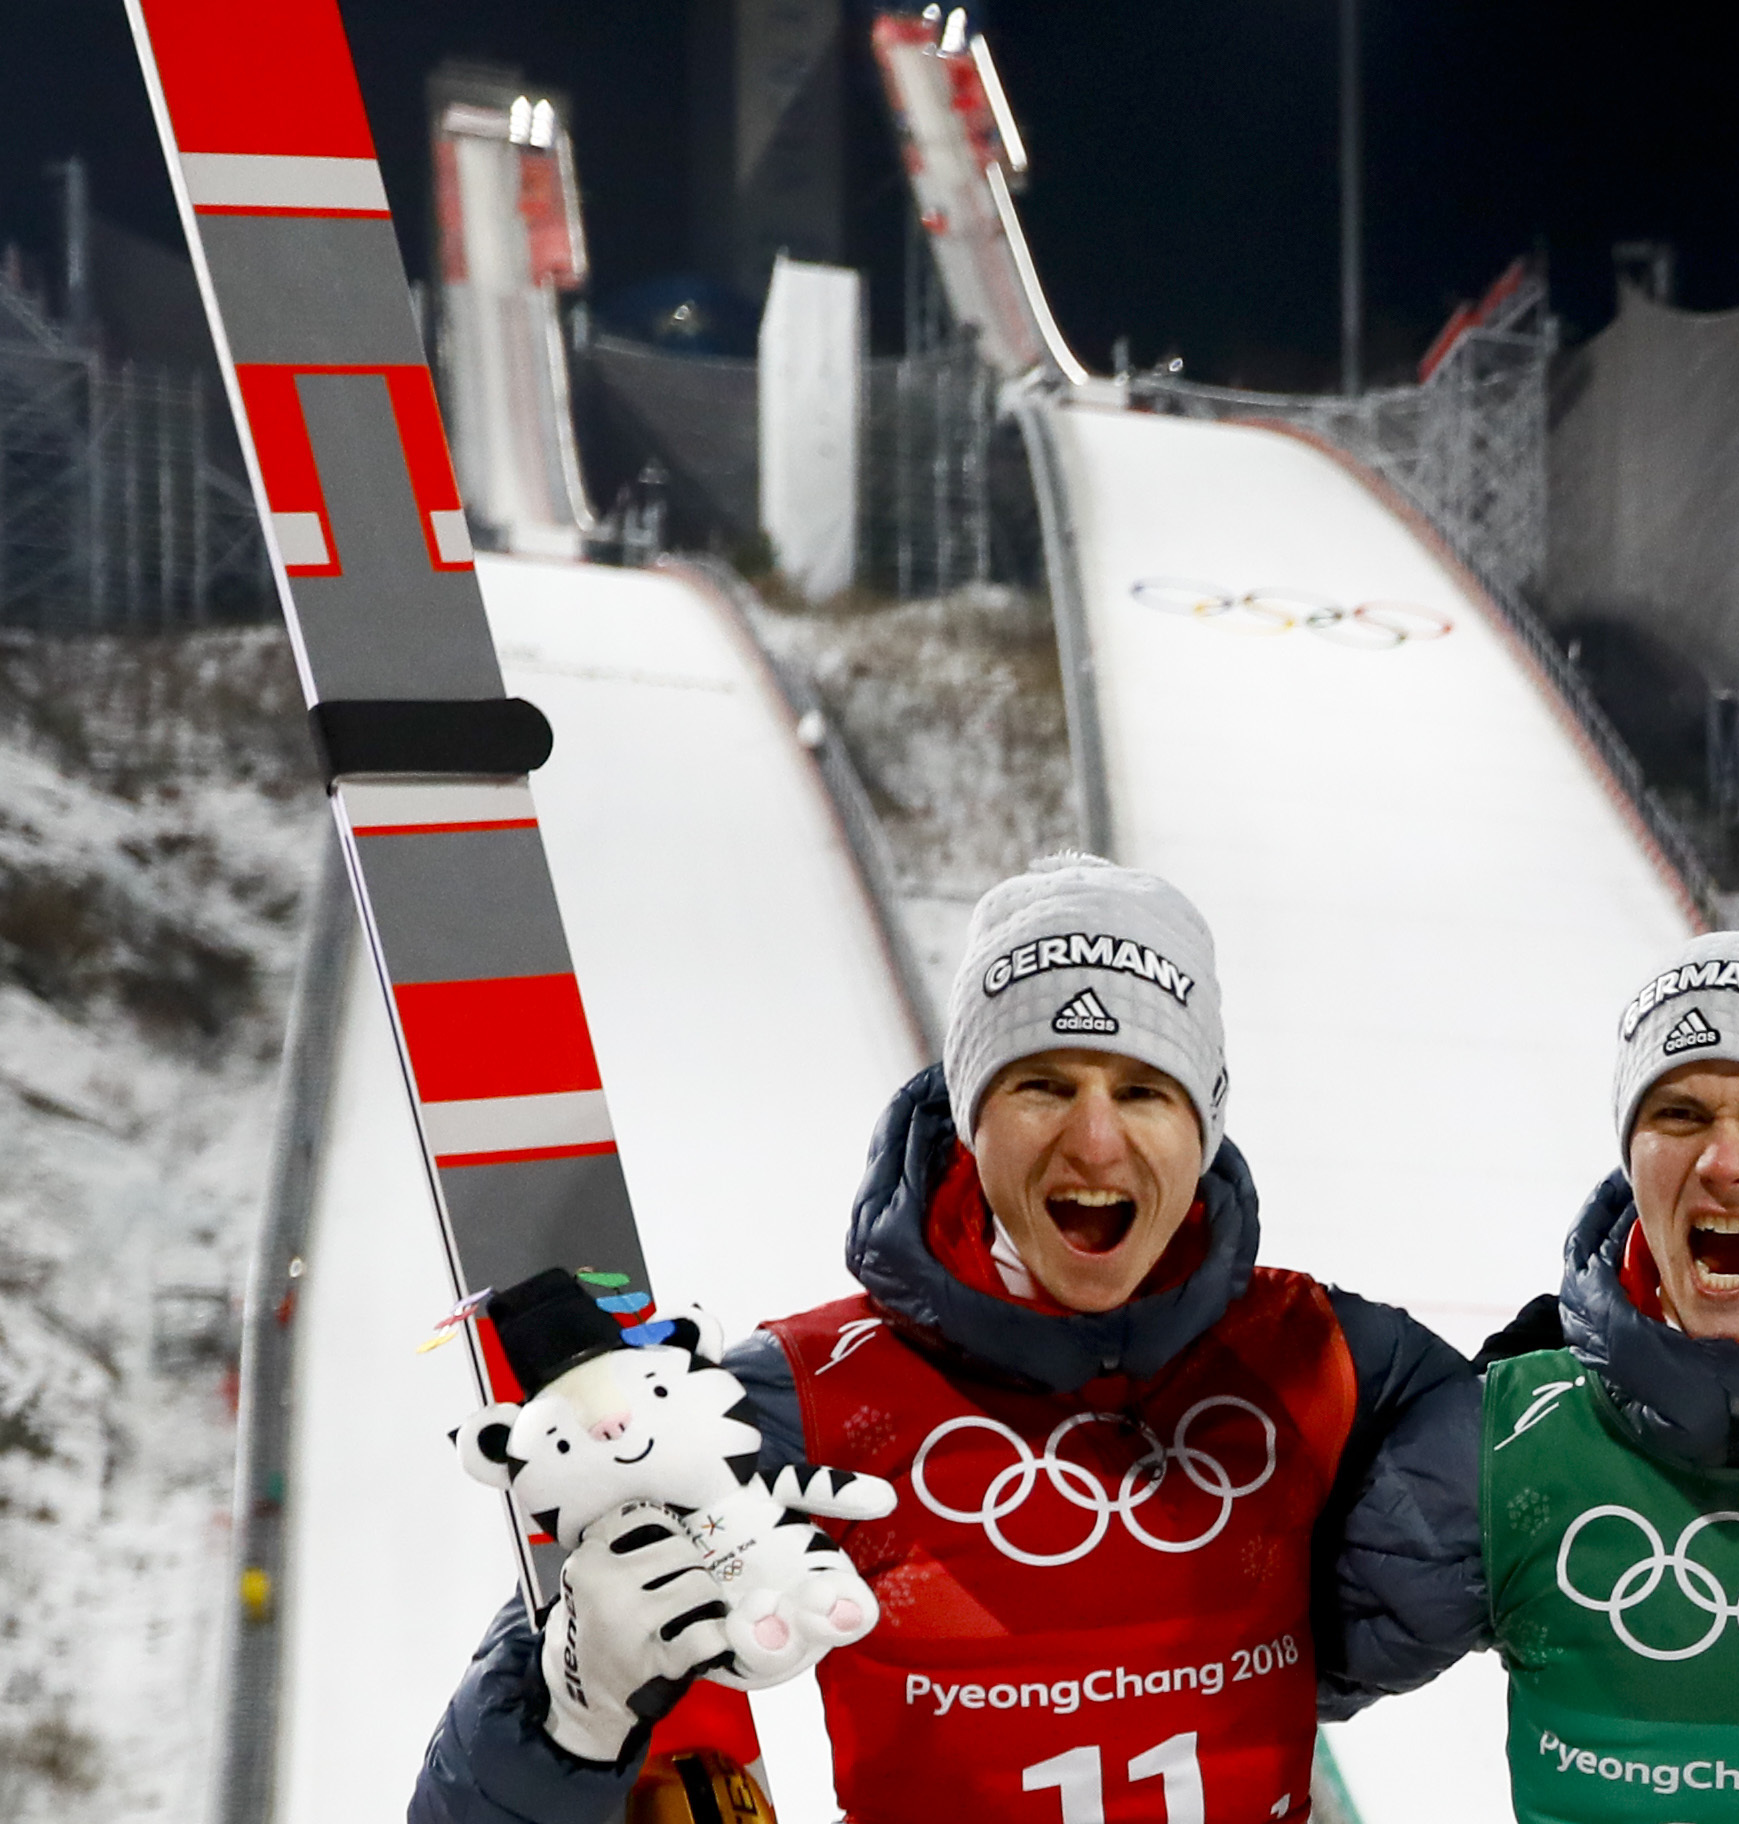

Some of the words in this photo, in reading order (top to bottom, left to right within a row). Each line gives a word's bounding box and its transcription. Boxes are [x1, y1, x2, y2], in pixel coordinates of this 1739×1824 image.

[984, 933, 1193, 1004] GERMANY
[1055, 1016, 1115, 1032] adidas
[1665, 1029, 1717, 1052] adidas
[905, 1667, 1225, 1716] PyeongChang
[1231, 1634, 1299, 1683] 2018
